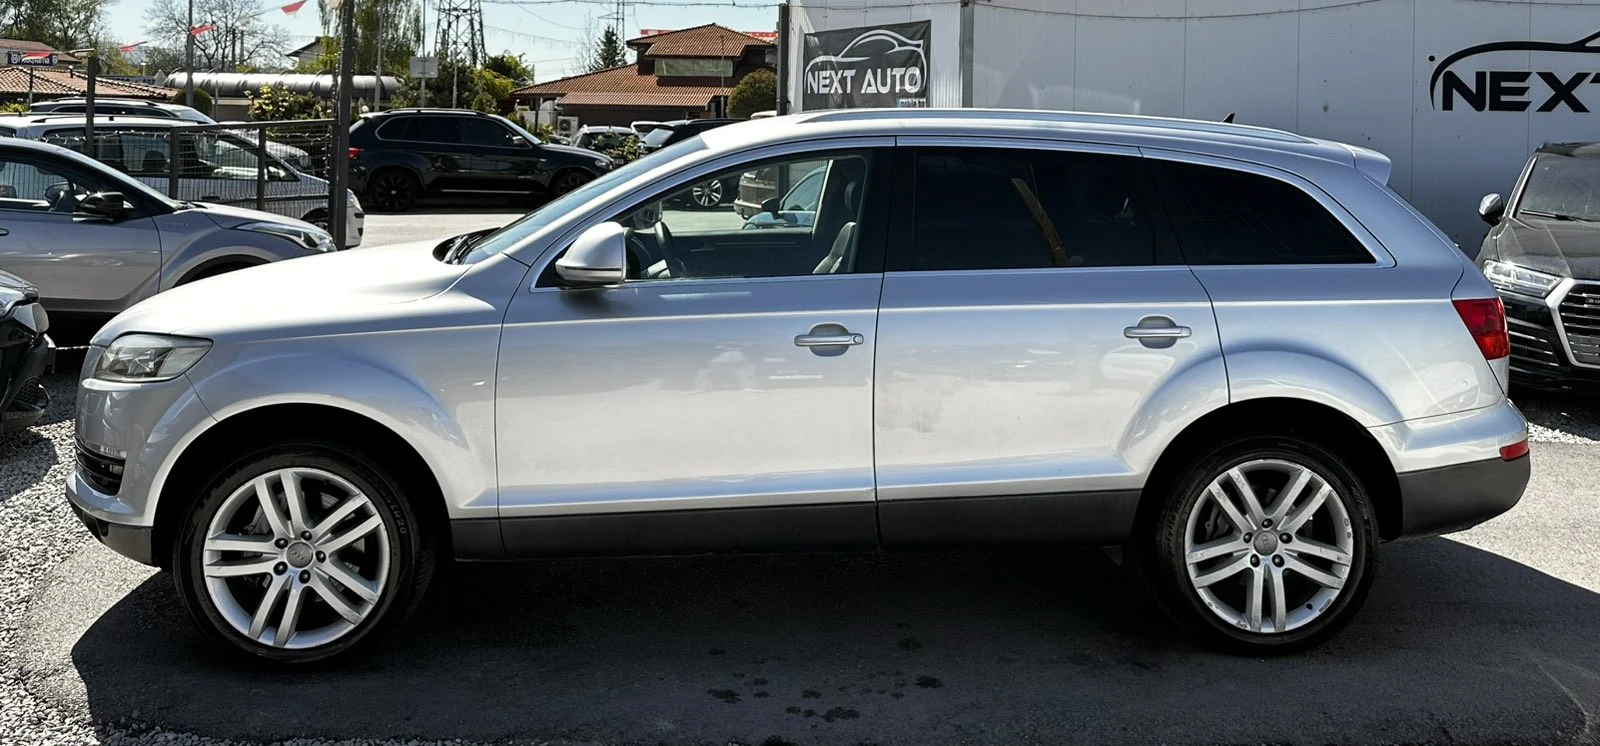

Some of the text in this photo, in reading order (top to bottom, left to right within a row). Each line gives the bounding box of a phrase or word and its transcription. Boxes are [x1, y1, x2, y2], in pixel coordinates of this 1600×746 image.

[807, 67, 922, 94] NEXT AUTO
[1442, 70, 1600, 113] NEX
